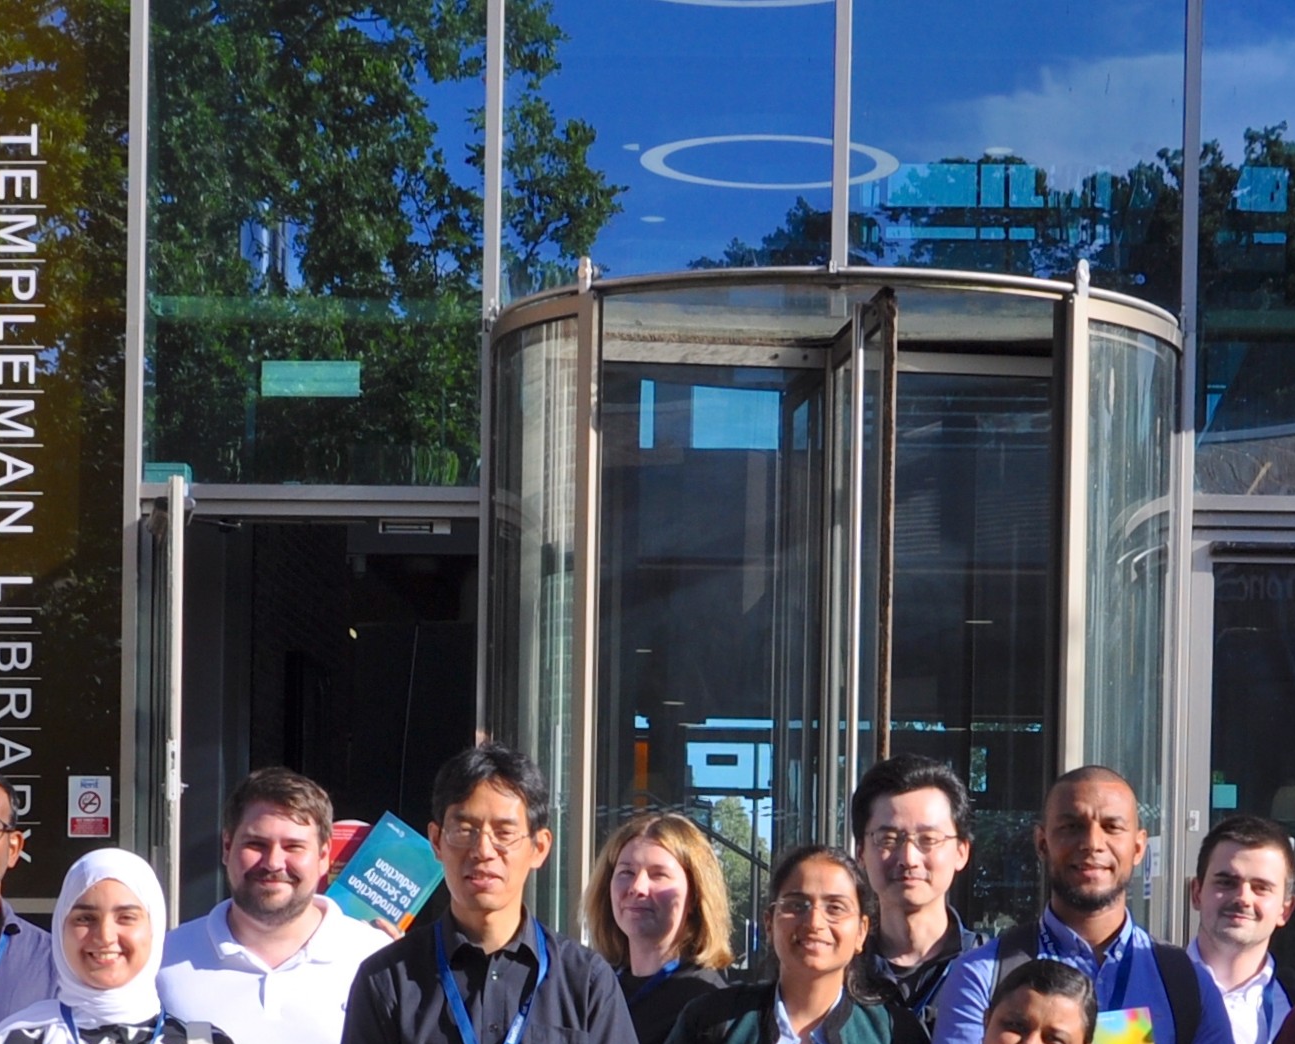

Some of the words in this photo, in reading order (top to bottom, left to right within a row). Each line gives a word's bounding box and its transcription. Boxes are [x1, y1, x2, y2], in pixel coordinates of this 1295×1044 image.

[363, 868, 402, 902] Security
[375, 858, 421, 898] Reduction
[347, 875, 403, 922] Introduction
[399, 893, 412, 909] to
